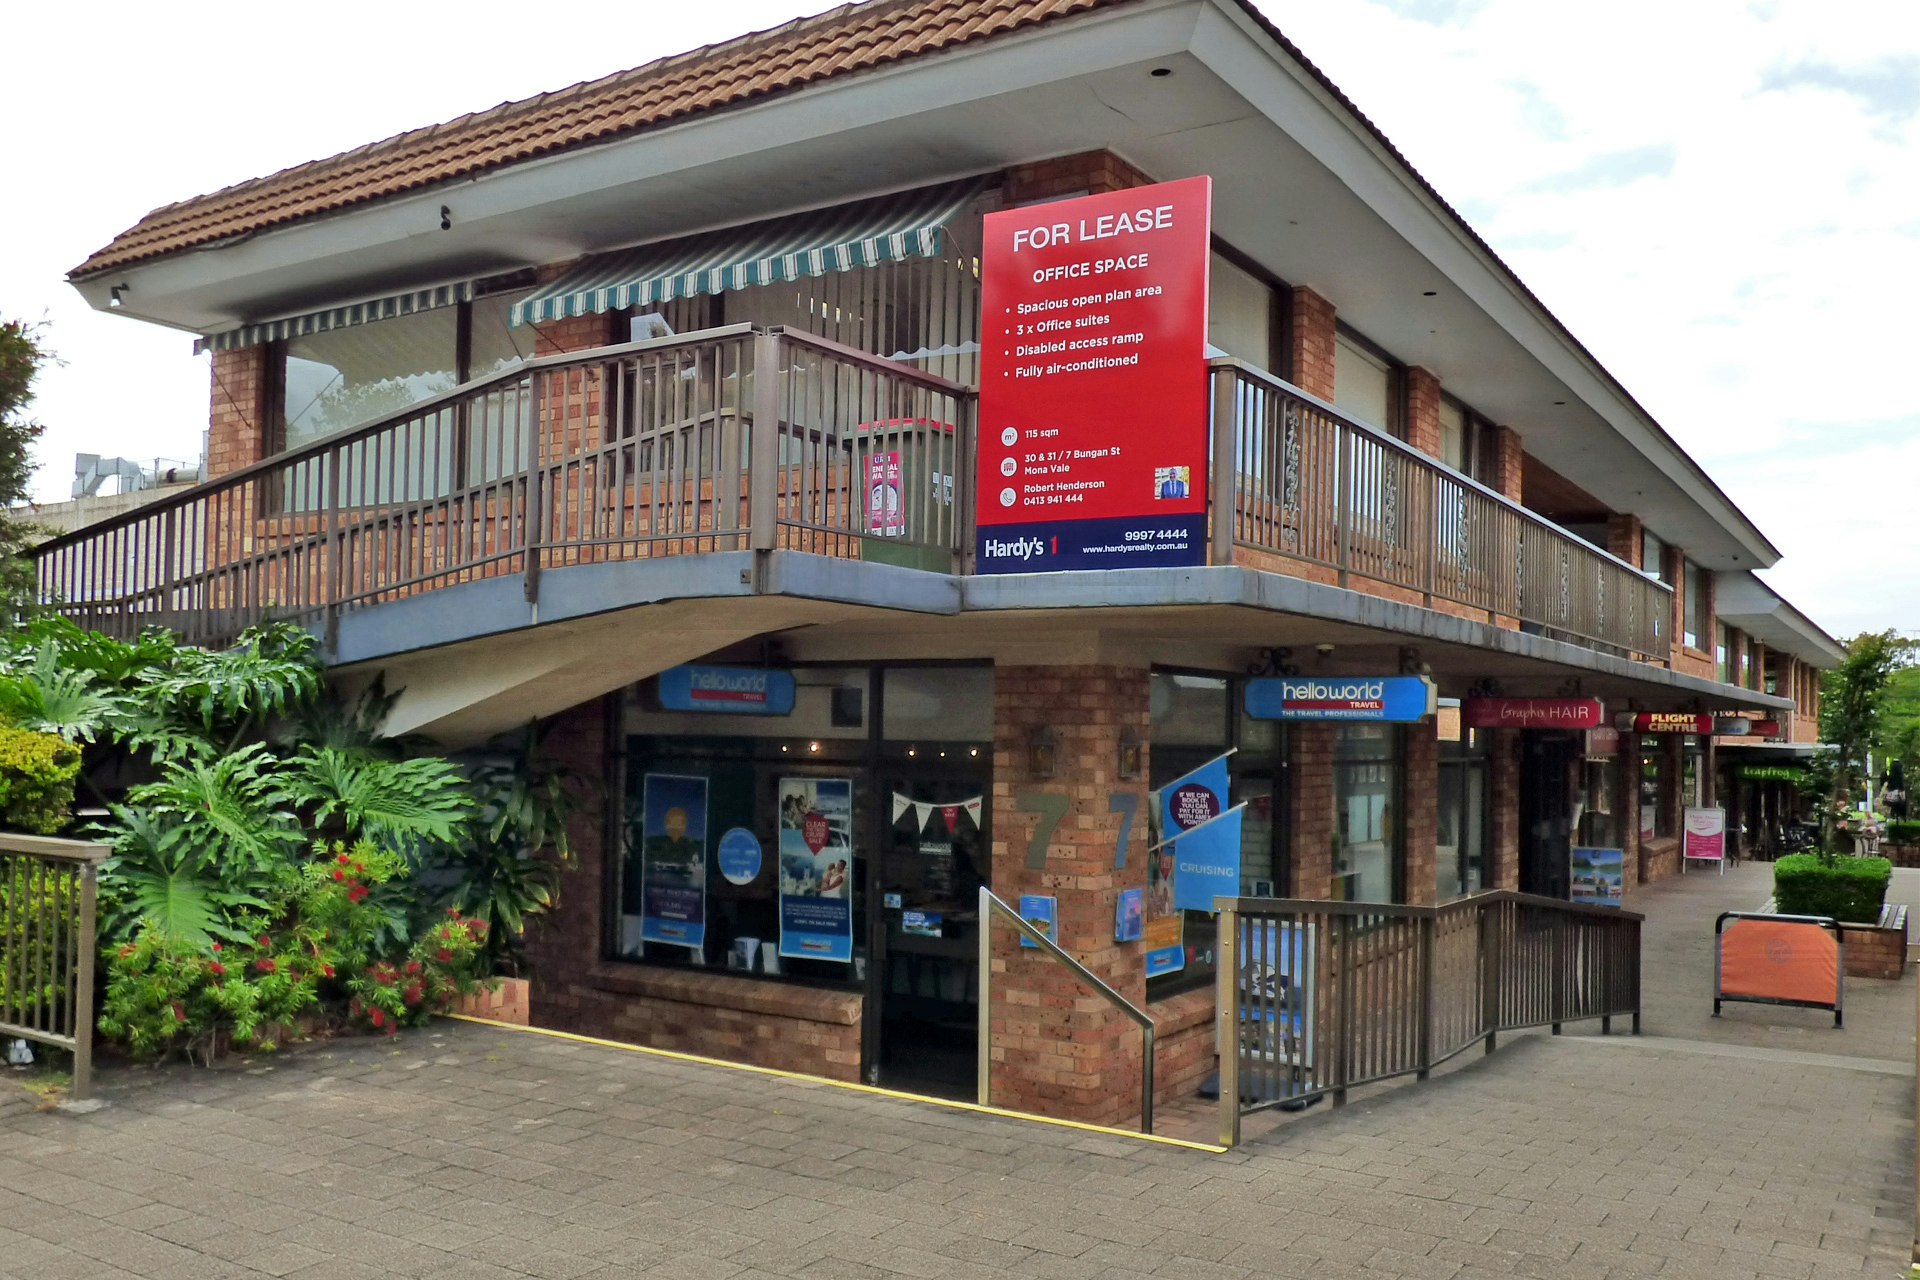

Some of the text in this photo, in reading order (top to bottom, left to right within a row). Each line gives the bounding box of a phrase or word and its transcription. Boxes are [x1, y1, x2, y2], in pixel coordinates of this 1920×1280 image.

[1013, 205, 1174, 252] FOR LEASE
[1033, 253, 1149, 283] OFFICE SPACE
[1017, 285, 1162, 314] Spacious open plan area
[1016, 314, 1110, 336] 3 x Office suites
[1016, 331, 1144, 357] Disabled access ramp
[1015, 353, 1139, 378] Fully air-conditioned
[1025, 427, 1059, 439] 115 sqm
[1025, 446, 1121, 463] 30 & 31 / 7 Bungan St
[1024, 463, 1070, 476] Mona Vale
[1024, 480, 1105, 493] Robert Henderson
[1023, 493, 1083, 506] 0413 941 444
[1125, 528, 1188, 542] 9997 4444
[985, 535, 1058, 561] Hardy's 1
[1082, 541, 1189, 555] www.hardysrealty.com.au
[1281, 681, 1384, 700] helloworld
[743, 694, 763, 702] TRAVEL
[1349, 701, 1380, 709] TRAVEL
[1325, 710, 1384, 718] PROFESSIONALS
[1549, 706, 1590, 720] HAIR
[1651, 713, 1697, 723] FLIGHT
[1648, 723, 1698, 733] CENTRE
[1015, 793, 1071, 870] 7
[1109, 793, 1139, 871] 7
[1180, 862, 1234, 877] CRUISING
